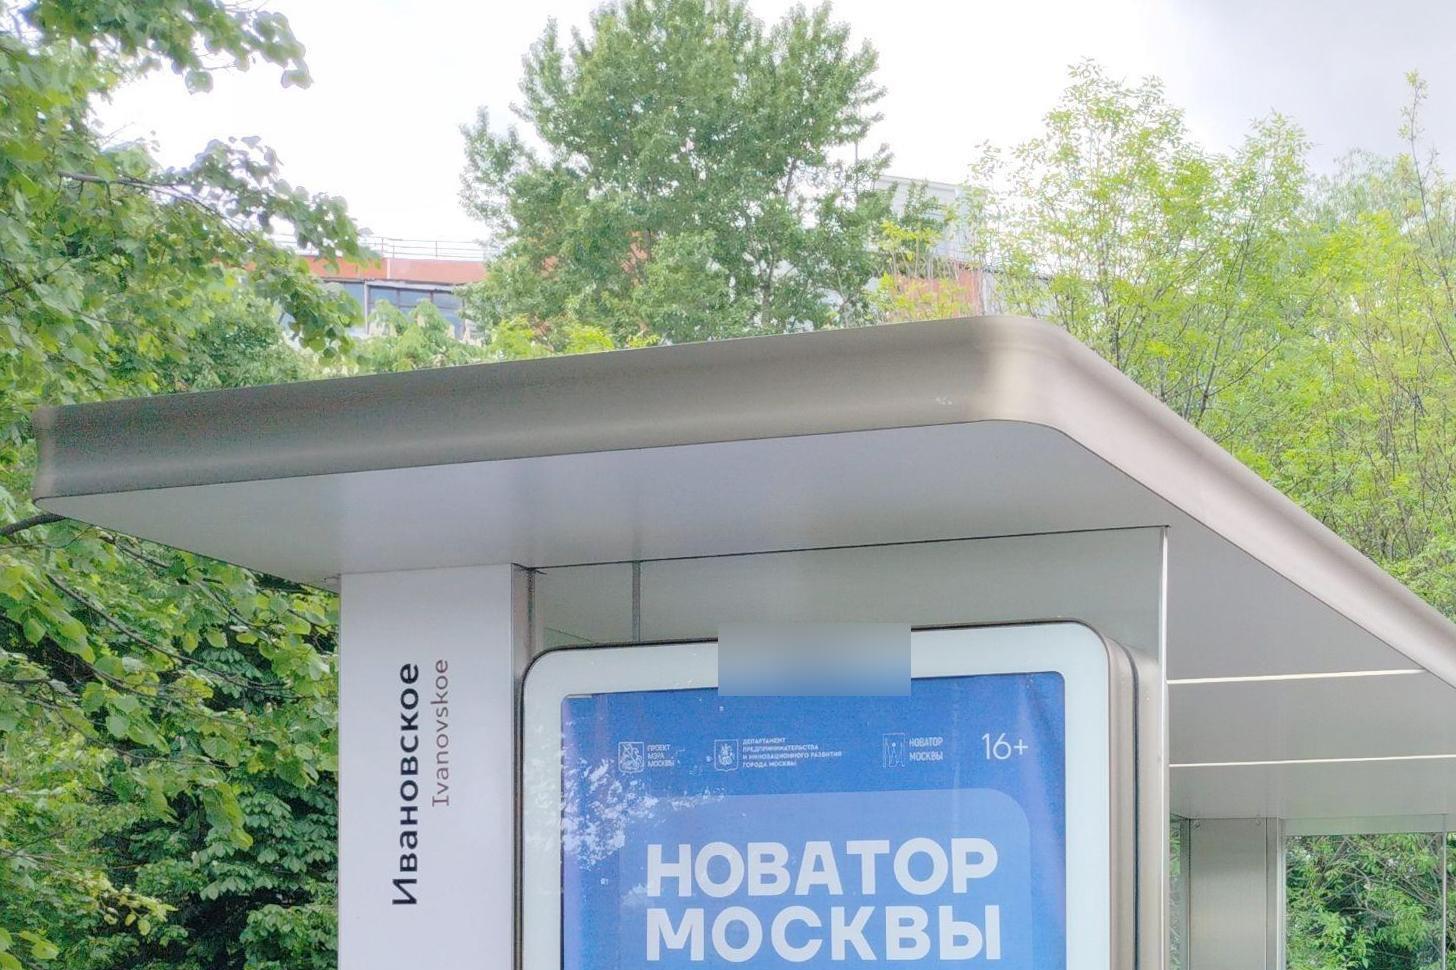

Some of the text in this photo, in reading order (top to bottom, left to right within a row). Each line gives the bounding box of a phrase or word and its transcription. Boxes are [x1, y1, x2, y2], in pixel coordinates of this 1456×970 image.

[430, 659, 449, 807] Ivanovskoe
[909, 737, 943, 748] НОВАТОР
[909, 751, 943, 761] МОСКВЫ
[981, 732, 1029, 760] 16+
[392, 663, 419, 905] Ивановское
[646, 837, 999, 898] НОВАТОР
[646, 904, 1001, 963] МОСКВЫ
